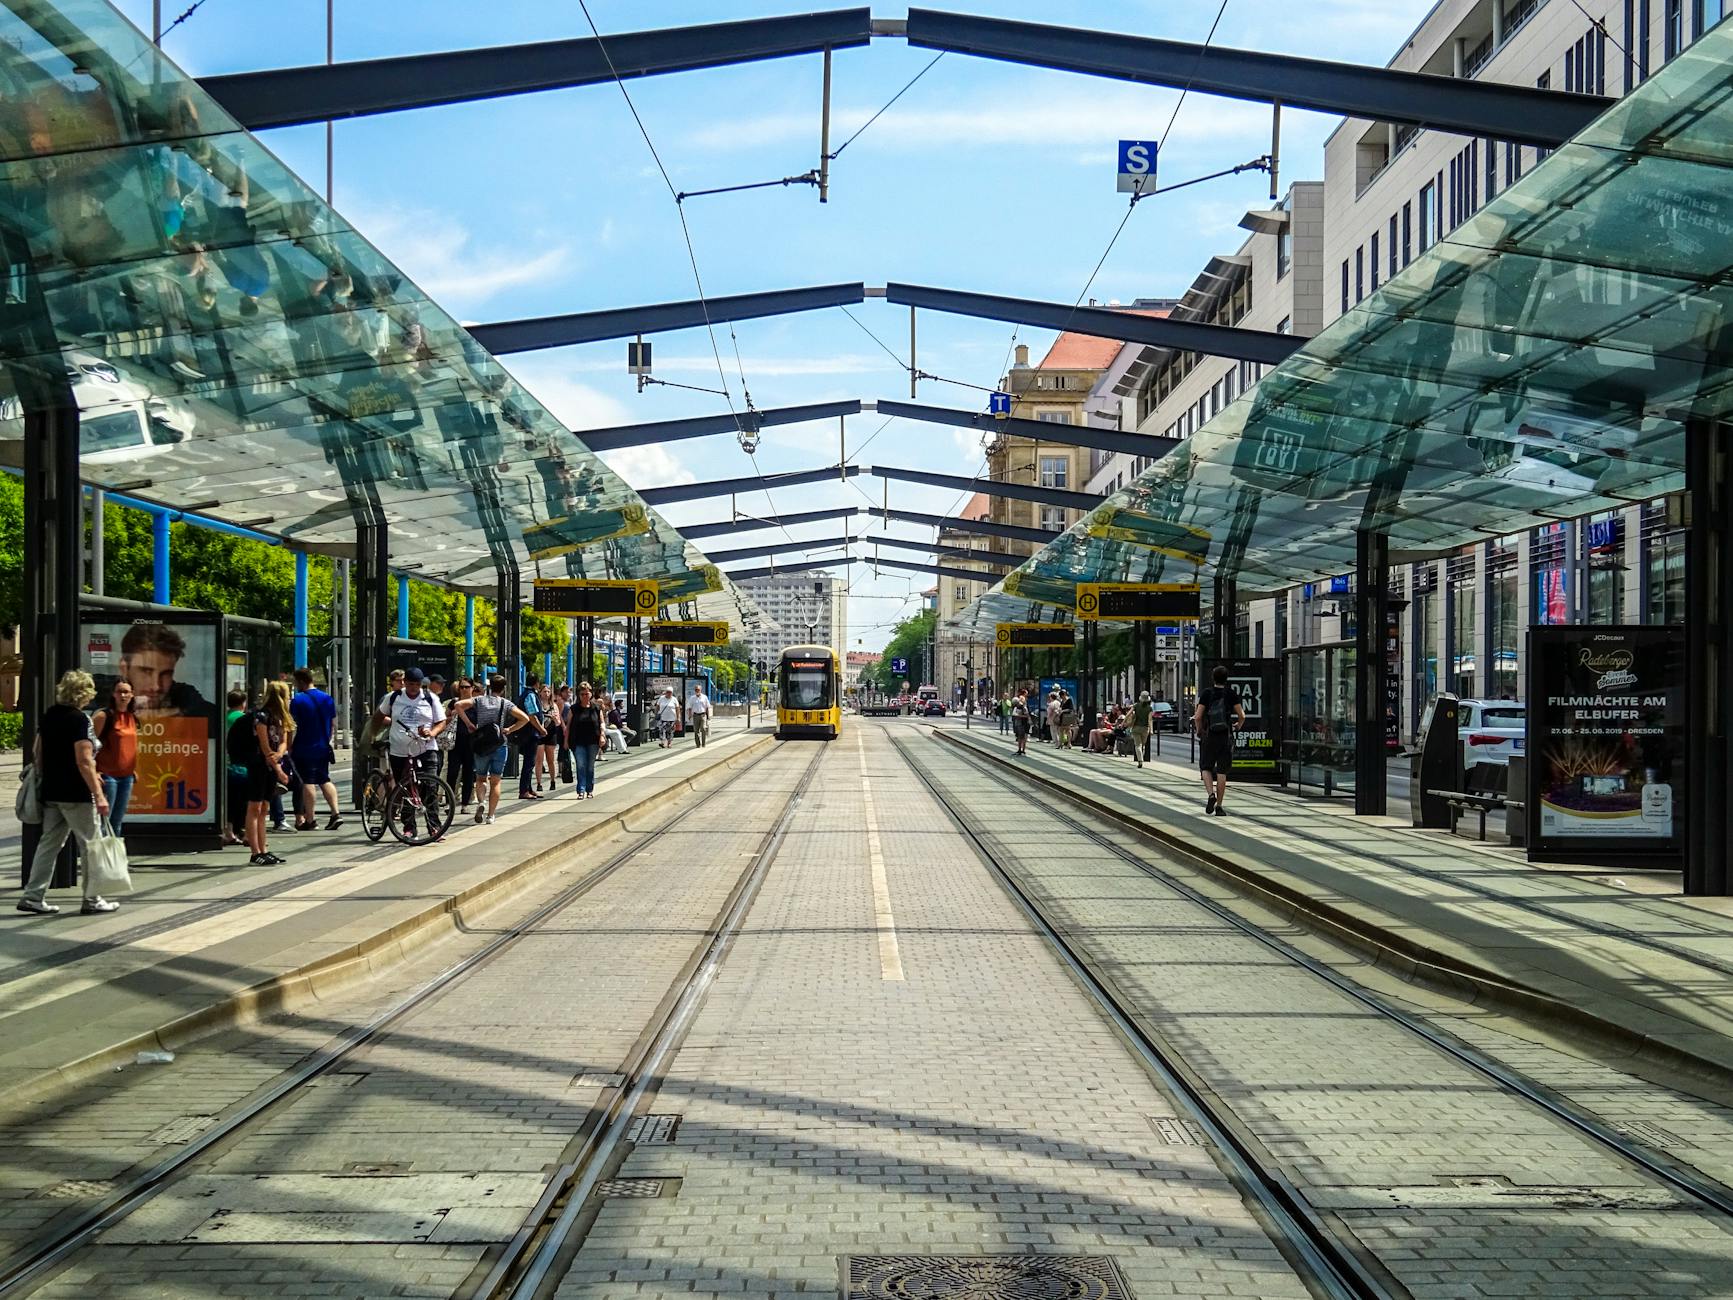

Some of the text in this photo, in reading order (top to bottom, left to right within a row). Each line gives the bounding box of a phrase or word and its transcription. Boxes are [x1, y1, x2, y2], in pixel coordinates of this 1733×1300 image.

[1126, 145, 1150, 174] S
[994, 395, 1006, 411] T
[900, 660, 906, 670] P
[1578, 648, 1634, 672] Radeberger
[1548, 695, 1667, 706] FILMNÄCHTE AM
[1575, 710, 1640, 719] ELBUFER
[1238, 731, 1267, 740] SPORT
[139, 741, 204, 757] hrgänge.
[166, 780, 202, 809] ils
